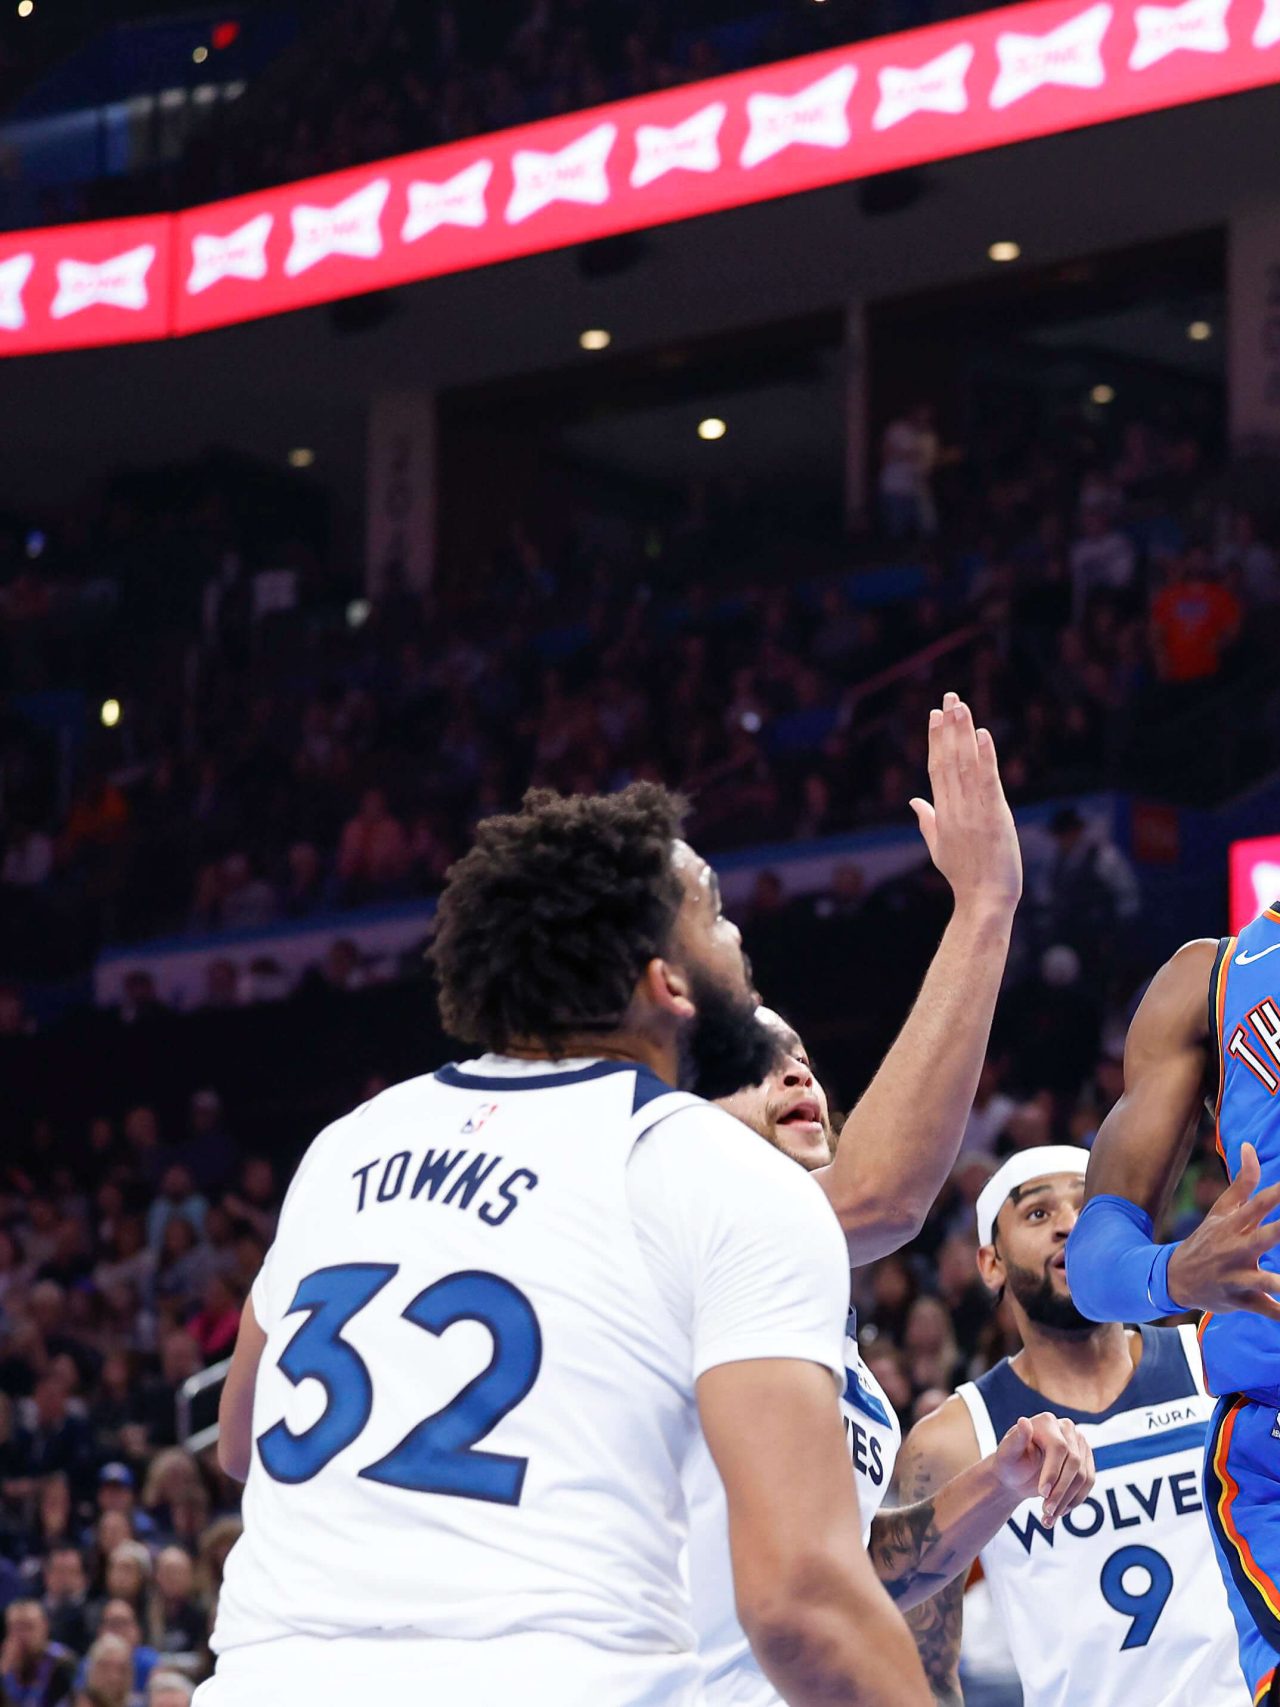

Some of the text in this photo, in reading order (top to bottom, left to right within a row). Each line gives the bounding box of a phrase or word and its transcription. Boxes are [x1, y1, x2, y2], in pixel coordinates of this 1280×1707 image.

[352, 1149, 539, 1226] TOWNS
[257, 1262, 542, 1506] 32
[843, 1416, 884, 1487] ES
[1100, 1544, 1173, 1651] 9
